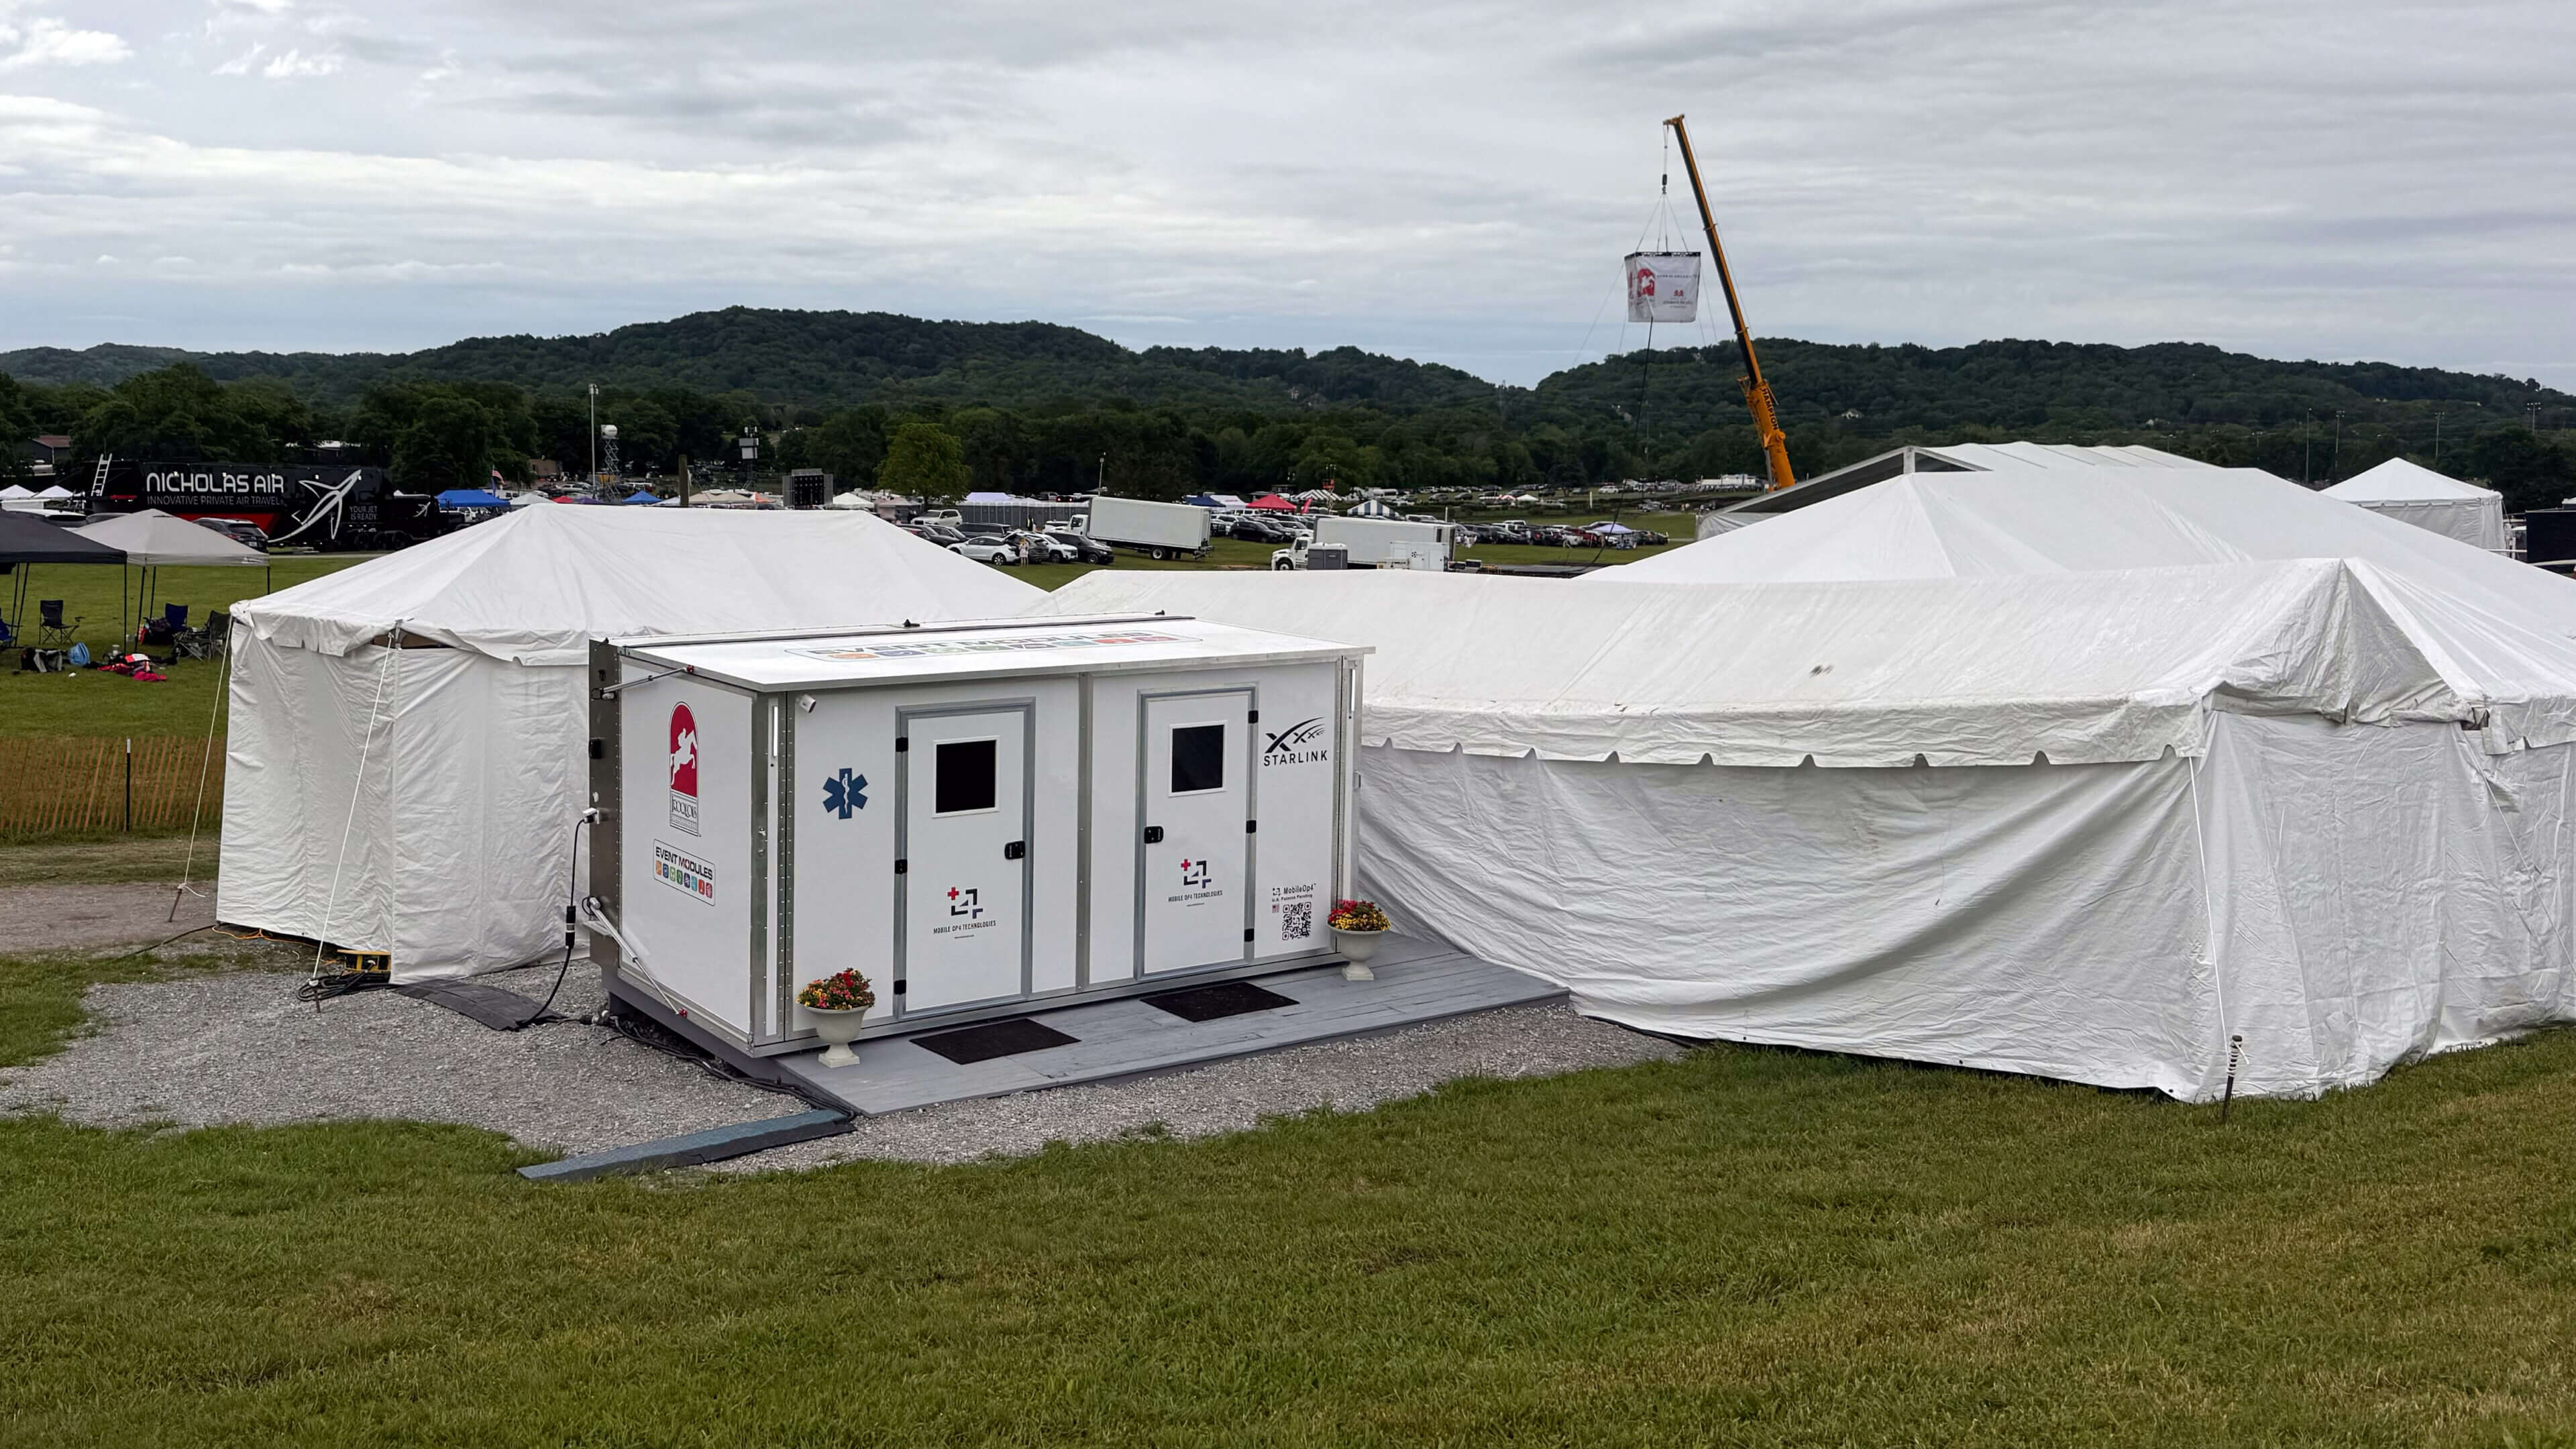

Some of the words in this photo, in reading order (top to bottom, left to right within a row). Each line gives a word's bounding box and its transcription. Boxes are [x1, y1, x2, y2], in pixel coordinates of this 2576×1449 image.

[1762, 388, 1777, 430] HAMPTON
[146, 472, 250, 493] NICHOLAS
[254, 474, 284, 493] AIR
[147, 495, 199, 505] INNOVATIVE
[201, 495, 234, 505] PRIVATE
[235, 495, 250, 505] AIR
[349, 505, 367, 513] YOUR
[809, 642, 949, 655] EVENT
[953, 631, 1154, 646] MODULES
[1263, 750, 1328, 767] STARLINK
[655, 847, 678, 864] EVENT
[678, 856, 712, 880] MODULES
[933, 926, 951, 934] MOBILE
[963, 920, 996, 930] TECHNOLOGIES
